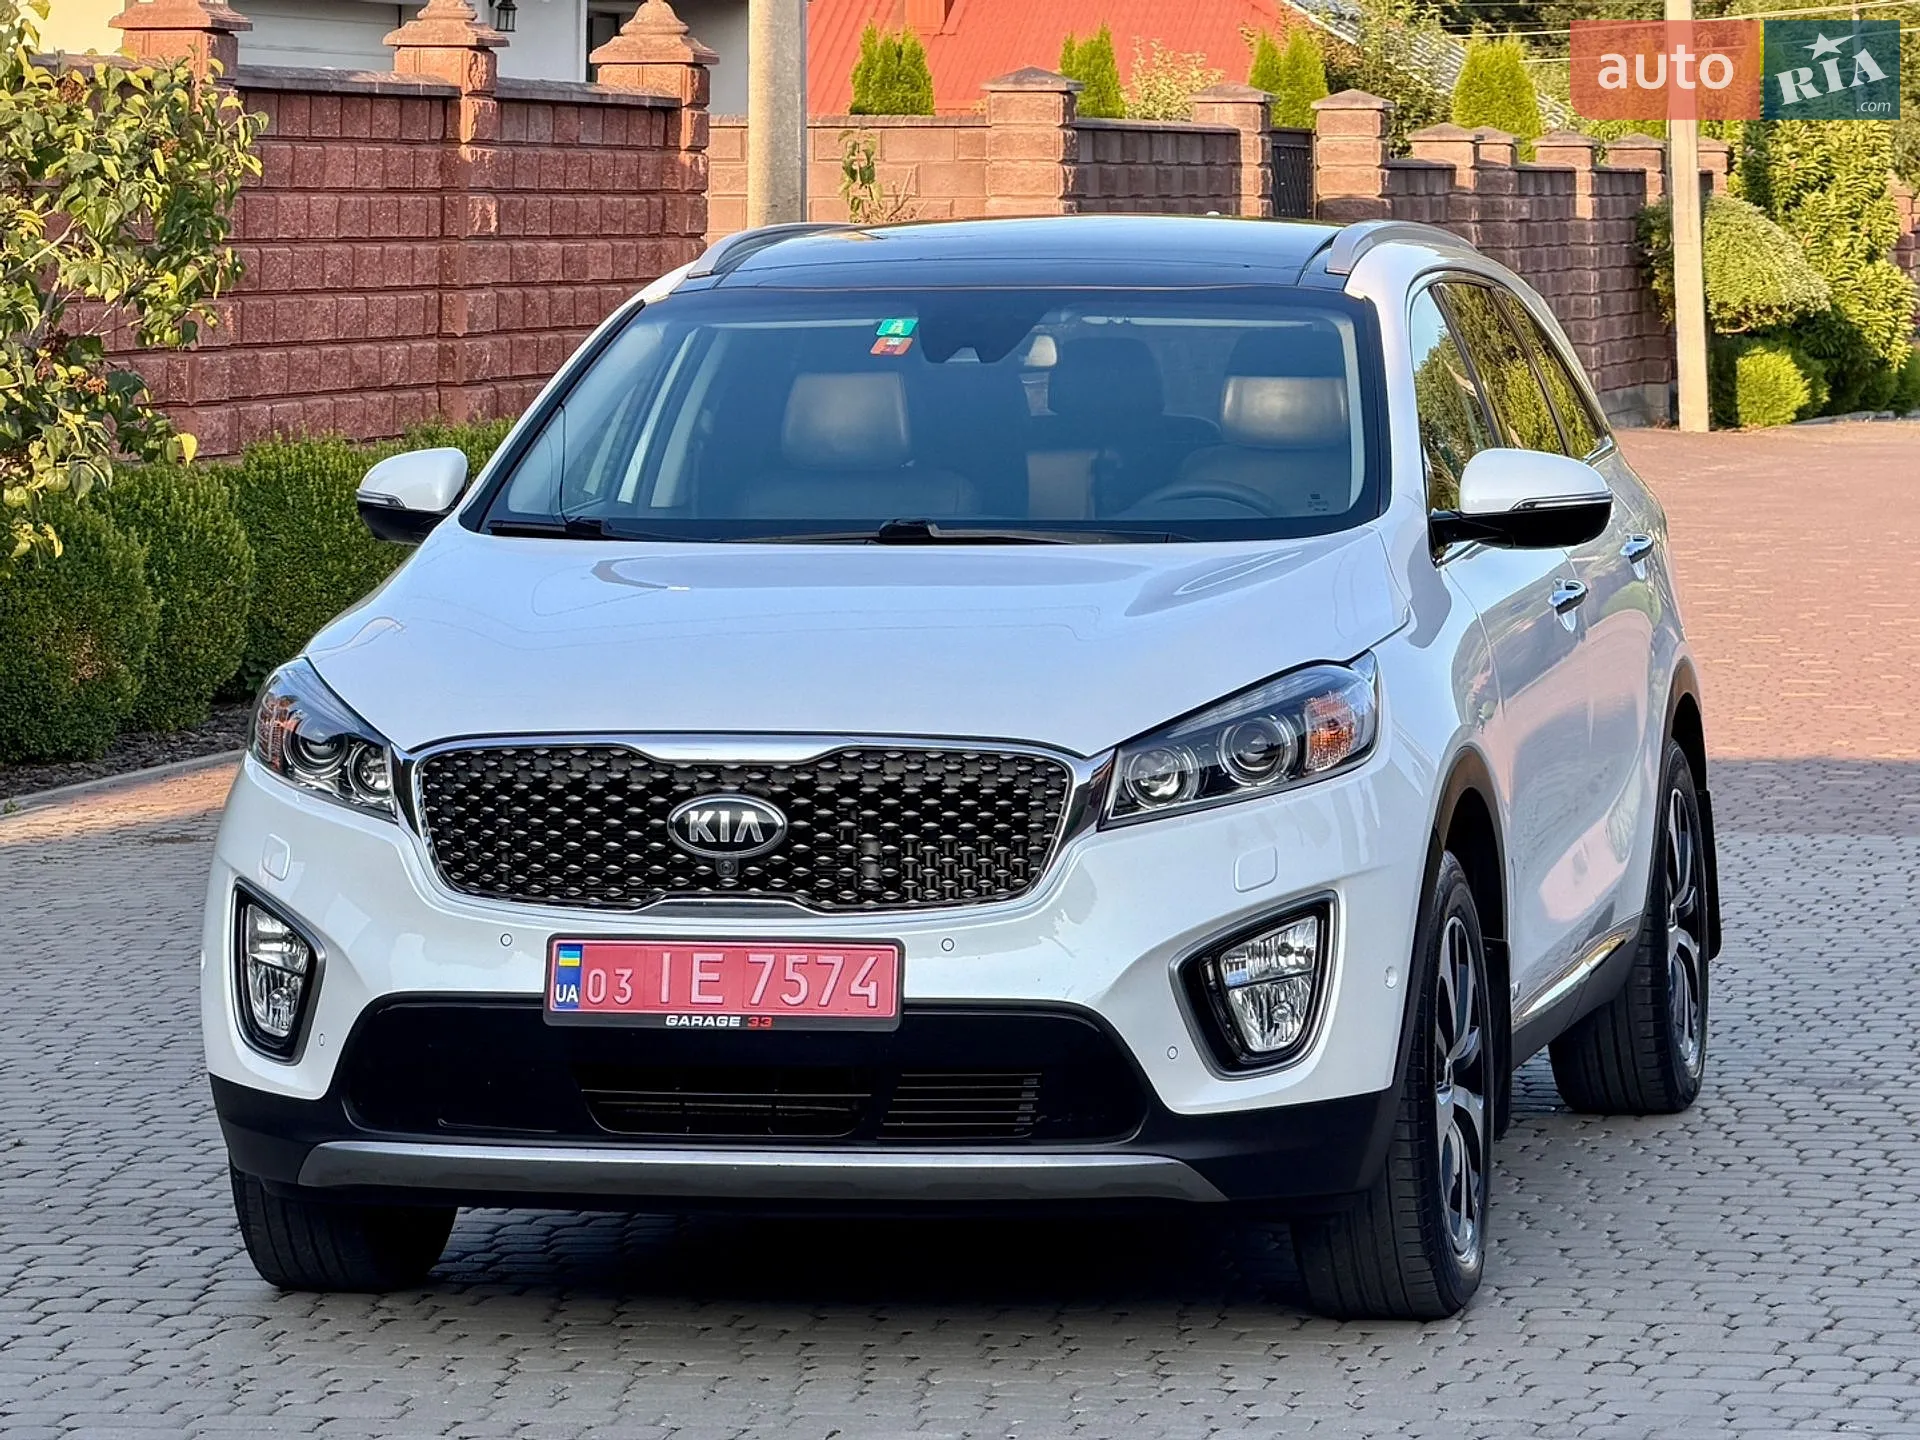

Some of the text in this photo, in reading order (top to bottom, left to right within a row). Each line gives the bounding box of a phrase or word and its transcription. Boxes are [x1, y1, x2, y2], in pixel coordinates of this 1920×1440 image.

[688, 810, 765, 843] KIA
[586, 951, 880, 1008] 03 IE 7574
[555, 984, 580, 1004] UA
[665, 1014, 773, 1028] GARAGE 33
